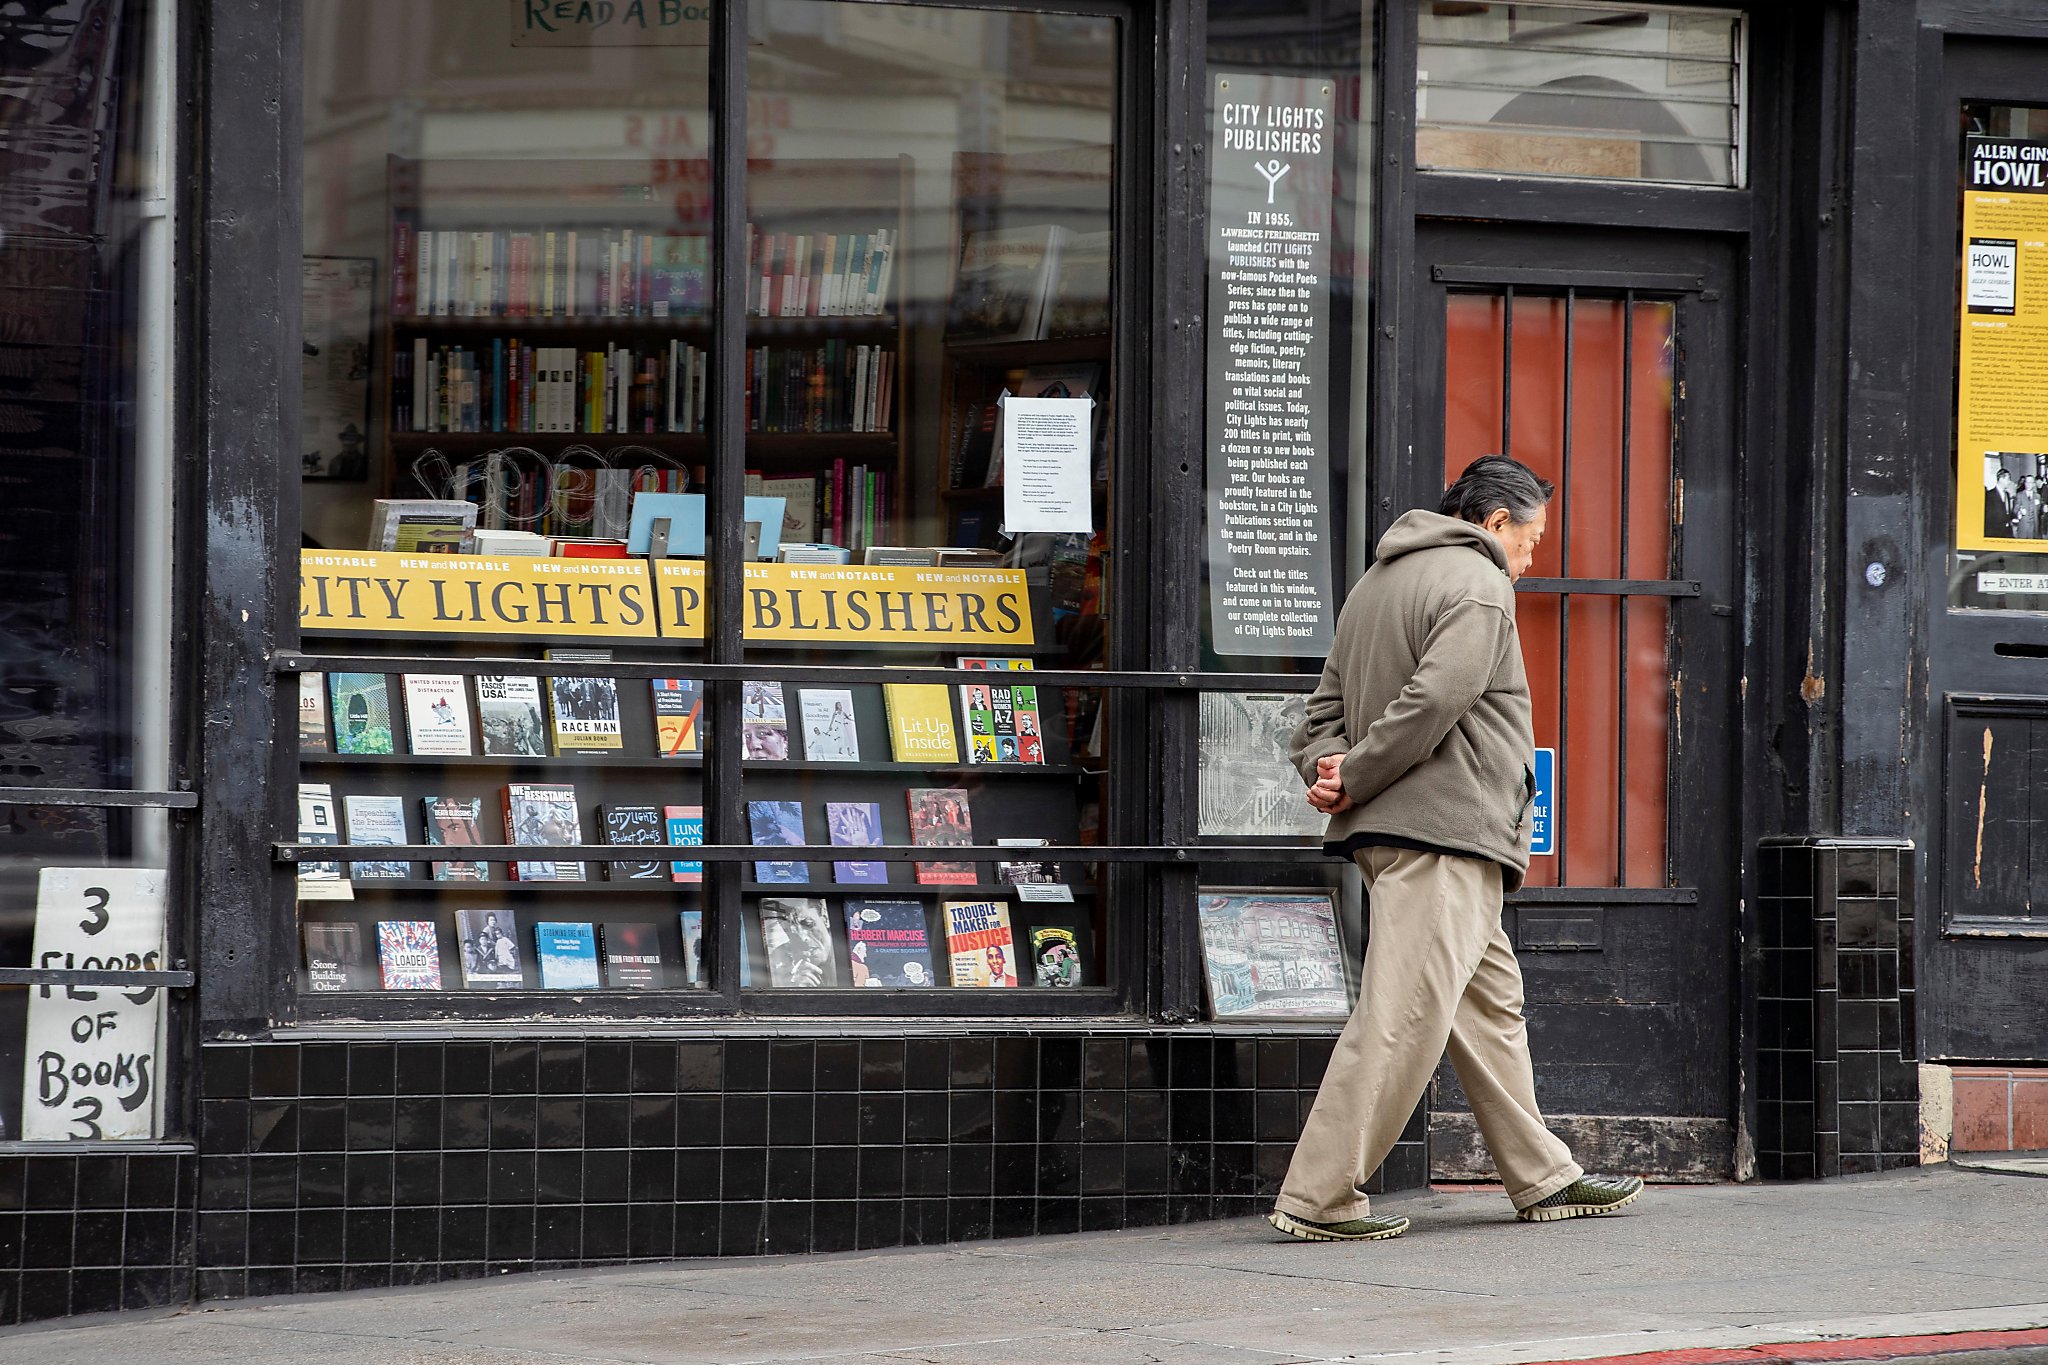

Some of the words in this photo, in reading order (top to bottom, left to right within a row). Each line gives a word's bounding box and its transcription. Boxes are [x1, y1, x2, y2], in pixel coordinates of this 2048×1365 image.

[525, 0, 615, 32] READ
[622, 0, 647, 28] A
[1223, 103, 1259, 125] CITY
[1268, 106, 1322, 129] LIGHTS
[1224, 128, 1320, 153] PUBLISHERS
[1973, 143, 2018, 160] ALLEN
[2020, 146, 2048, 161] GIN
[1973, 160, 2046, 187] HOWL
[1248, 211, 1261, 224] IN
[1265, 212, 1292, 226] 1955,
[1221, 227, 1263, 238] LAWRENCE
[1264, 230, 1319, 241] FERLINGHETTI
[1227, 240, 1261, 252] launched
[1263, 242, 1281, 253] CITY
[1284, 243, 1312, 255] LIGHTS
[1229, 254, 1276, 267] PUBLISHERS
[1278, 257, 1294, 268] with
[1296, 258, 1309, 269] the
[1972, 253, 2010, 268] HOWL
[1221, 269, 1266, 281] now-famous
[1269, 271, 1293, 283] Pocket
[1296, 272, 1316, 284] Poets
[1227, 283, 1253, 297] Series;
[1256, 285, 1276, 296] since
[1278, 286, 1295, 297] then
[1297, 287, 1310, 298] the
[1229, 300, 1249, 313] press
[1251, 299, 1265, 310] has
[1267, 302, 1286, 313] gone
[1288, 303, 1297, 311] on
[1300, 302, 1308, 312] to
[1223, 312, 1251, 325] publish
[1253, 316, 1258, 324] a
[1260, 314, 1278, 325] wide
[1280, 317, 1302, 328] range
[1304, 316, 1313, 327] of
[1222, 327, 1244, 339] titles,
[1247, 328, 1281, 342] including
[1283, 330, 1313, 343] cutting-
[1230, 342, 1248, 355] edge
[1250, 342, 1277, 356] fiction,
[1279, 345, 1305, 357] poetry,
[1235, 357, 1270, 369] memoirs,
[1272, 358, 1300, 371] literary
[1225, 370, 1269, 382] translations
[1271, 372, 1285, 383] and
[1288, 373, 1310, 384] books
[316, 557, 376, 567] NOTABLE
[400, 559, 429, 569] NEW
[431, 561, 448, 569] and
[449, 561, 510, 571] NOTABLE
[533, 563, 561, 572] NEW
[563, 565, 579, 574] and
[581, 565, 642, 575] NOTABLE
[664, 566, 690, 576] NEW
[693, 568, 705, 577] an
[790, 570, 817, 579] NEW
[819, 571, 835, 580] and
[837, 571, 895, 581] NOTABLE
[916, 573, 943, 582] NEW
[945, 575, 960, 583] and
[962, 574, 1020, 584] NOTABLE
[1233, 567, 1256, 578] Check
[1258, 569, 1271, 578] out
[1273, 568, 1285, 579] the
[1287, 569, 1308, 579] titles
[1225, 581, 1258, 592] featured
[1260, 582, 1267, 592] in
[1270, 582, 1284, 593] this
[1286, 583, 1316, 595] window,
[1998, 578, 2033, 588] ENTER
[429, 579, 645, 626] LIGHTS
[670, 586, 1021, 633] PBLISHERS
[1222, 595, 1237, 605] and
[1239, 598, 1259, 606] come
[1273, 597, 1281, 607] in
[1283, 598, 1291, 607] to
[1293, 597, 1321, 608] browse
[1227, 612, 1240, 620] our
[1243, 610, 1278, 623] complete
[1280, 611, 1317, 622] collection
[1234, 624, 1242, 634] of
[1244, 624, 1259, 637] City
[1262, 625, 1285, 637] Lights
[1287, 625, 1312, 636] Books!
[482, 690, 507, 698] USA!
[991, 688, 1011, 700] RAD
[994, 710, 1013, 723] A-Z
[561, 722, 590, 732] RACE
[594, 723, 616, 732] MAN
[901, 717, 922, 733] Lit
[926, 718, 949, 736] Up
[904, 733, 952, 749] Inside
[509, 786, 524, 796] WE
[524, 790, 576, 802] RESISTANCE
[354, 809, 398, 818] Impeaching
[607, 812, 631, 830] CITY
[631, 811, 658, 825] LIGHTS
[79, 886, 110, 936] 3
[950, 903, 997, 921] TROUBLE
[953, 917, 989, 935] MAKER
[990, 920, 1001, 928] FOR
[543, 929, 567, 937] STORMING
[568, 929, 577, 937] THE
[578, 929, 590, 938] WALL
[850, 929, 886, 941] HERBERT
[887, 929, 926, 941] MARCUSE
[951, 926, 1012, 953] JUSTICE
[313, 960, 338, 969] Stone
[395, 955, 427, 966] LOADED
[609, 955, 622, 963] TORN
[623, 955, 634, 963] FROM
[634, 955, 642, 963] THE
[642, 955, 660, 964] WORLD
[310, 970, 346, 983] Building
[314, 981, 341, 991] Other
[71, 1011, 117, 1043] OF
[68, 1096, 103, 1140] 3
